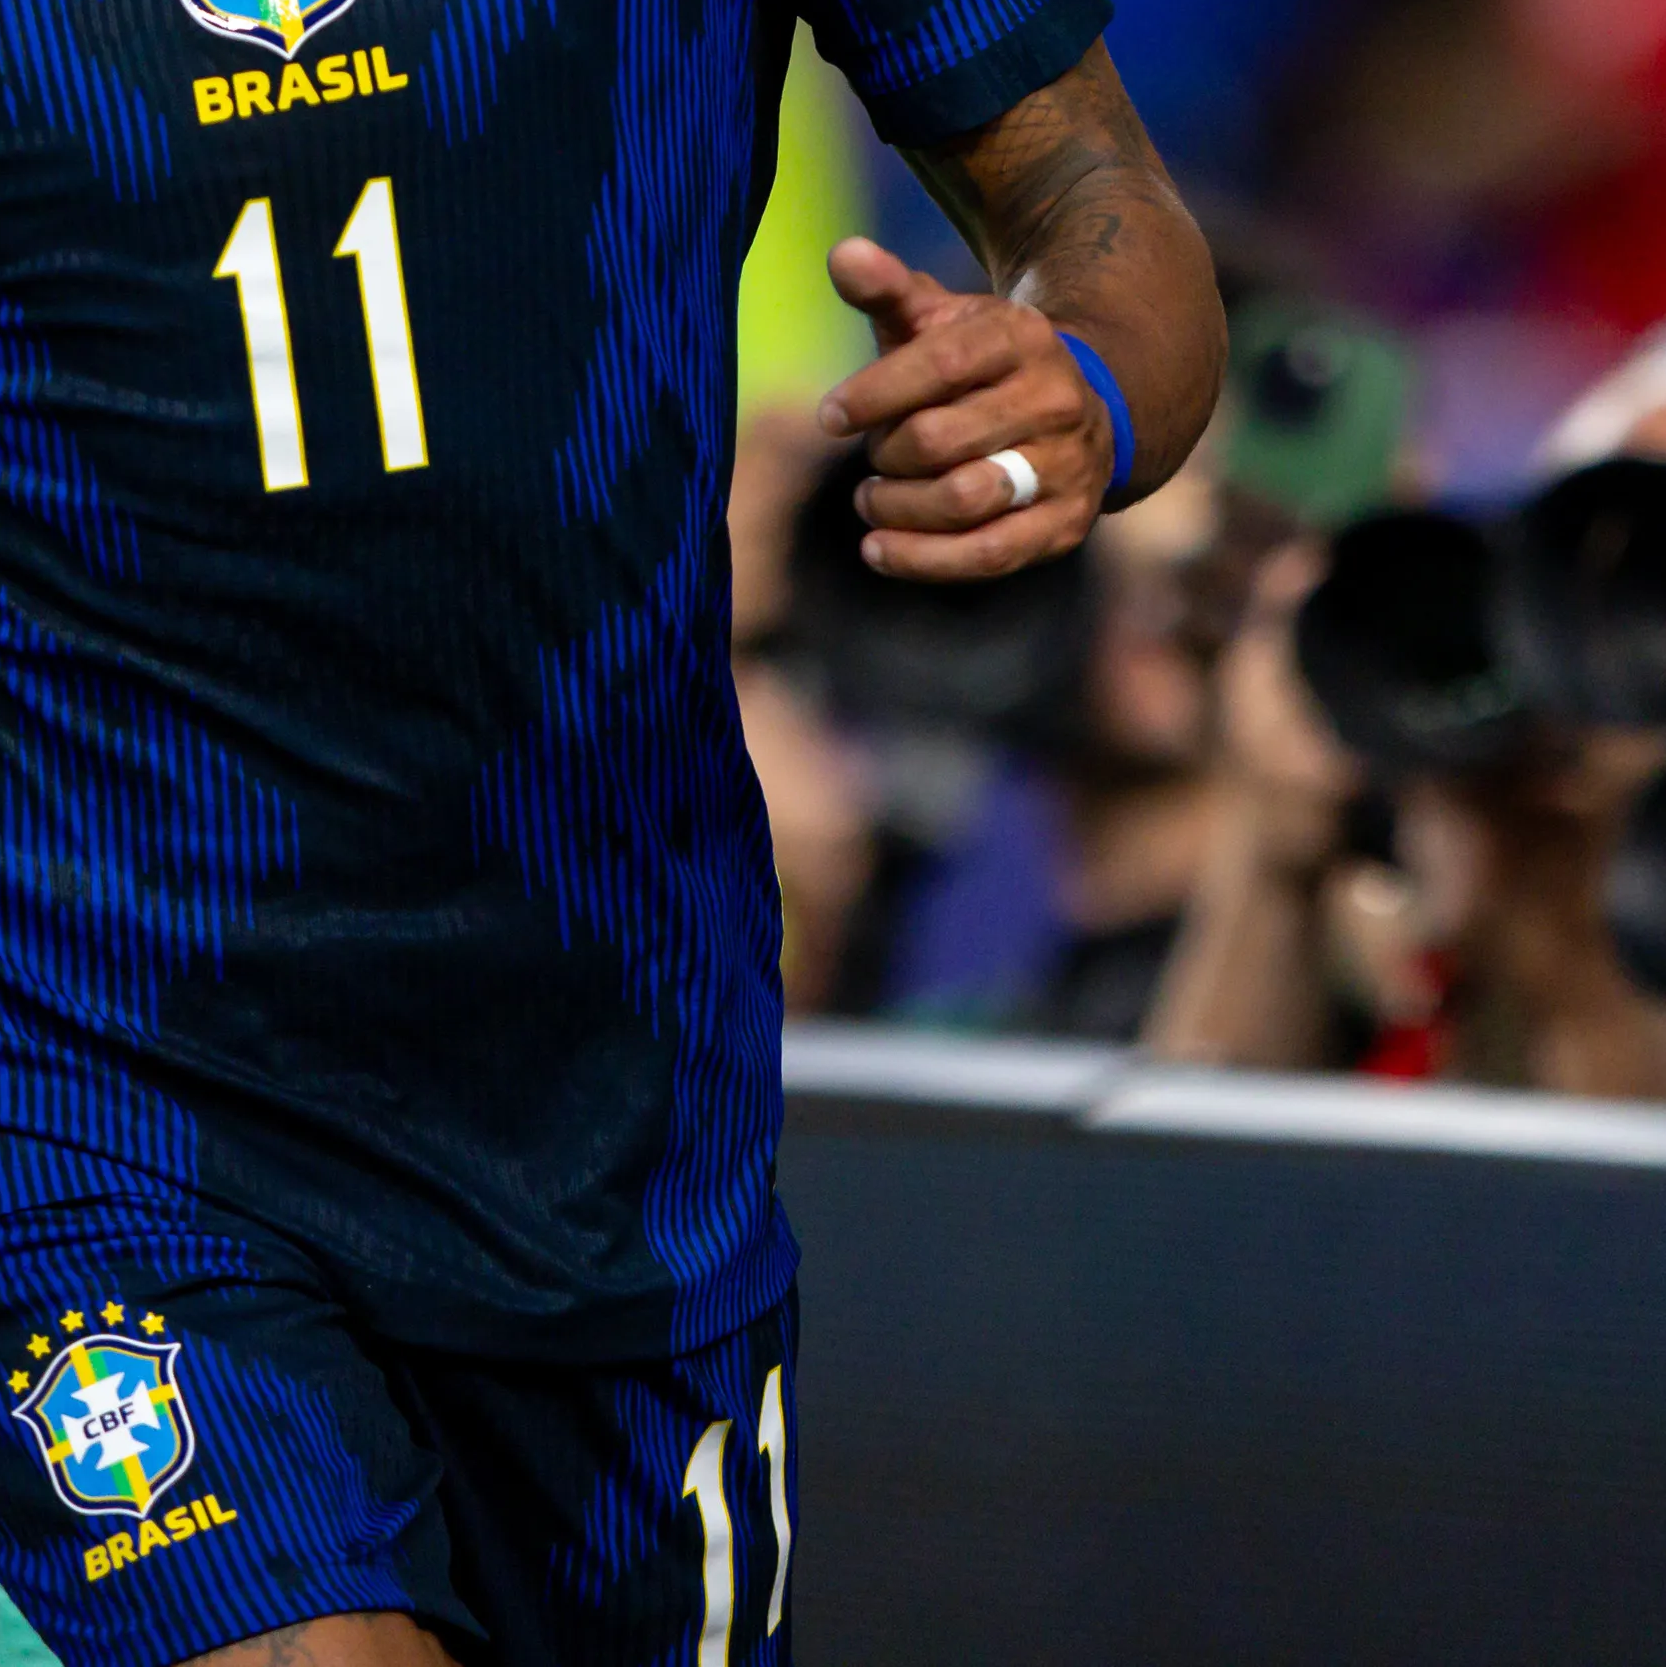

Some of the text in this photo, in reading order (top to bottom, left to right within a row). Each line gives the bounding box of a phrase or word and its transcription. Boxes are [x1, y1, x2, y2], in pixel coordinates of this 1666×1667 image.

[193, 45, 408, 125] BRASIL
[212, 176, 429, 493] 11
[82, 1401, 136, 1440] CBF
[84, 1493, 238, 1582] BRASIL
[682, 1364, 791, 1667] 11
